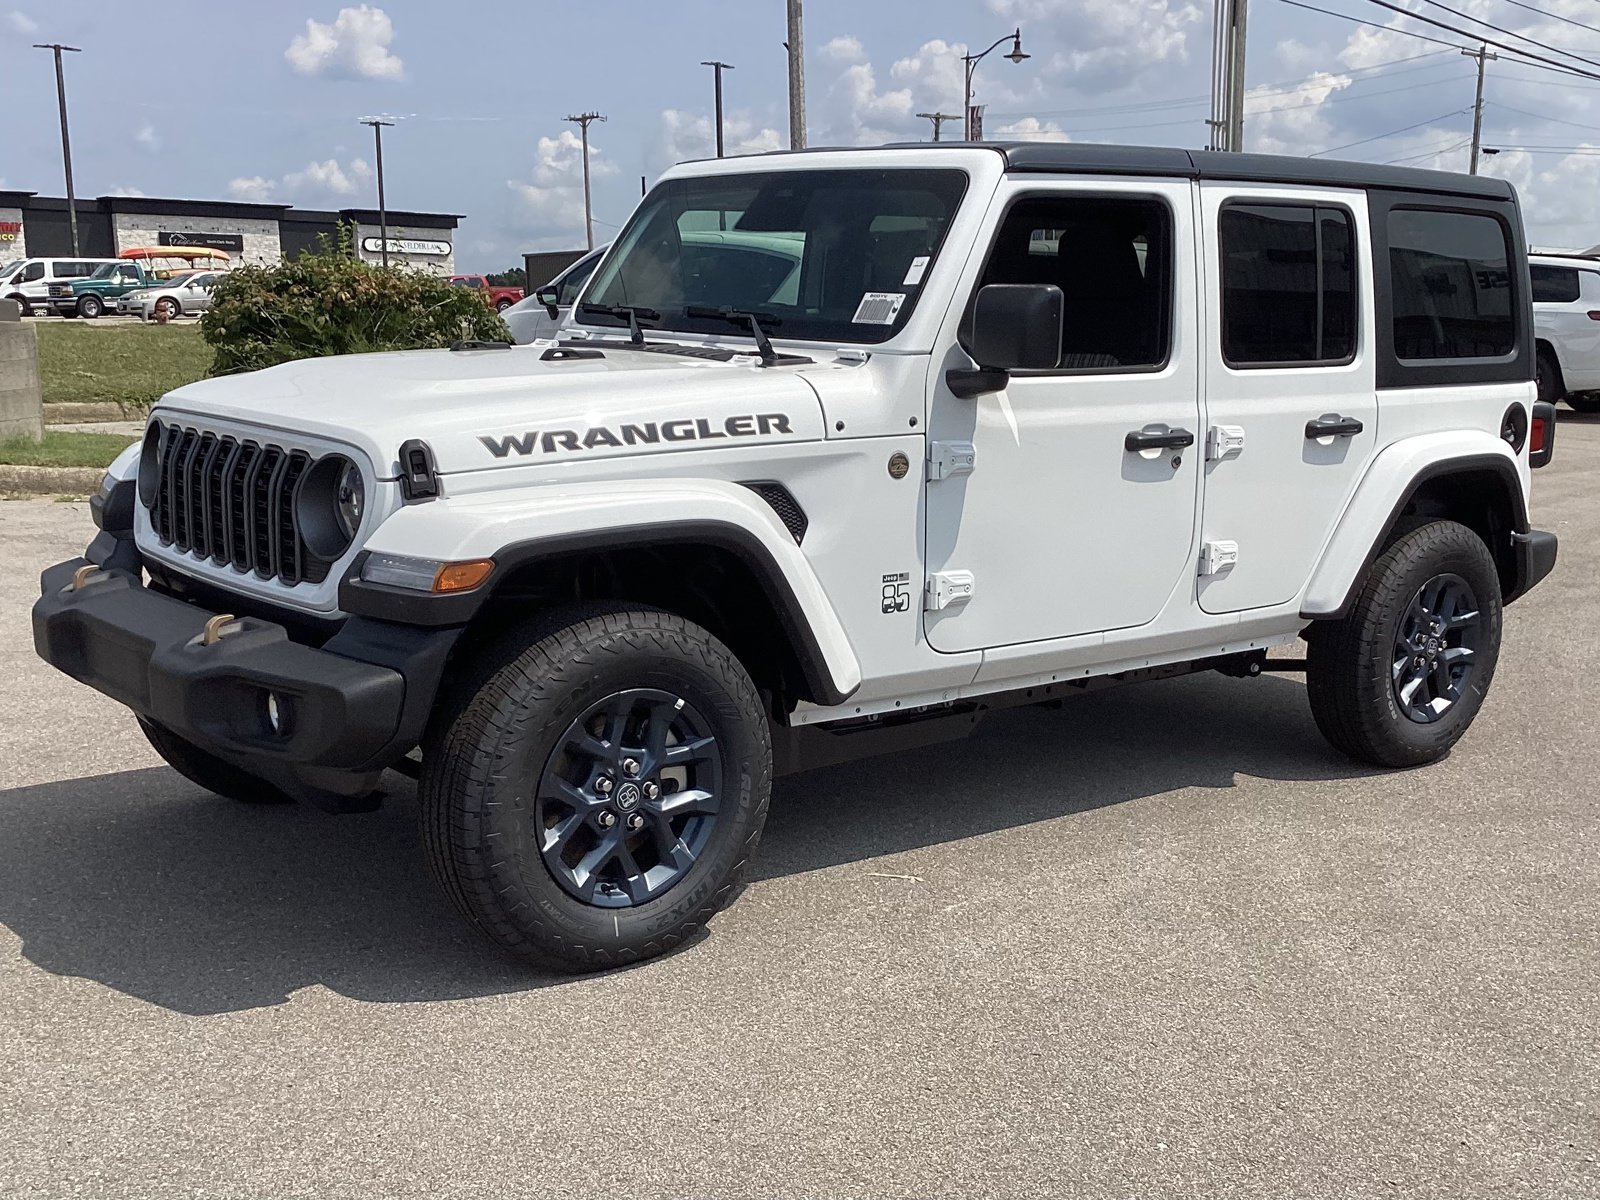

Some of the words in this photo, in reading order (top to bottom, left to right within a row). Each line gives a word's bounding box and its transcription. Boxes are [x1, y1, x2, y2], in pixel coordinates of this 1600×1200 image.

[477, 413, 794, 458] WRANGLER
[882, 583, 910, 613] 85
[620, 787, 638, 808] 85
